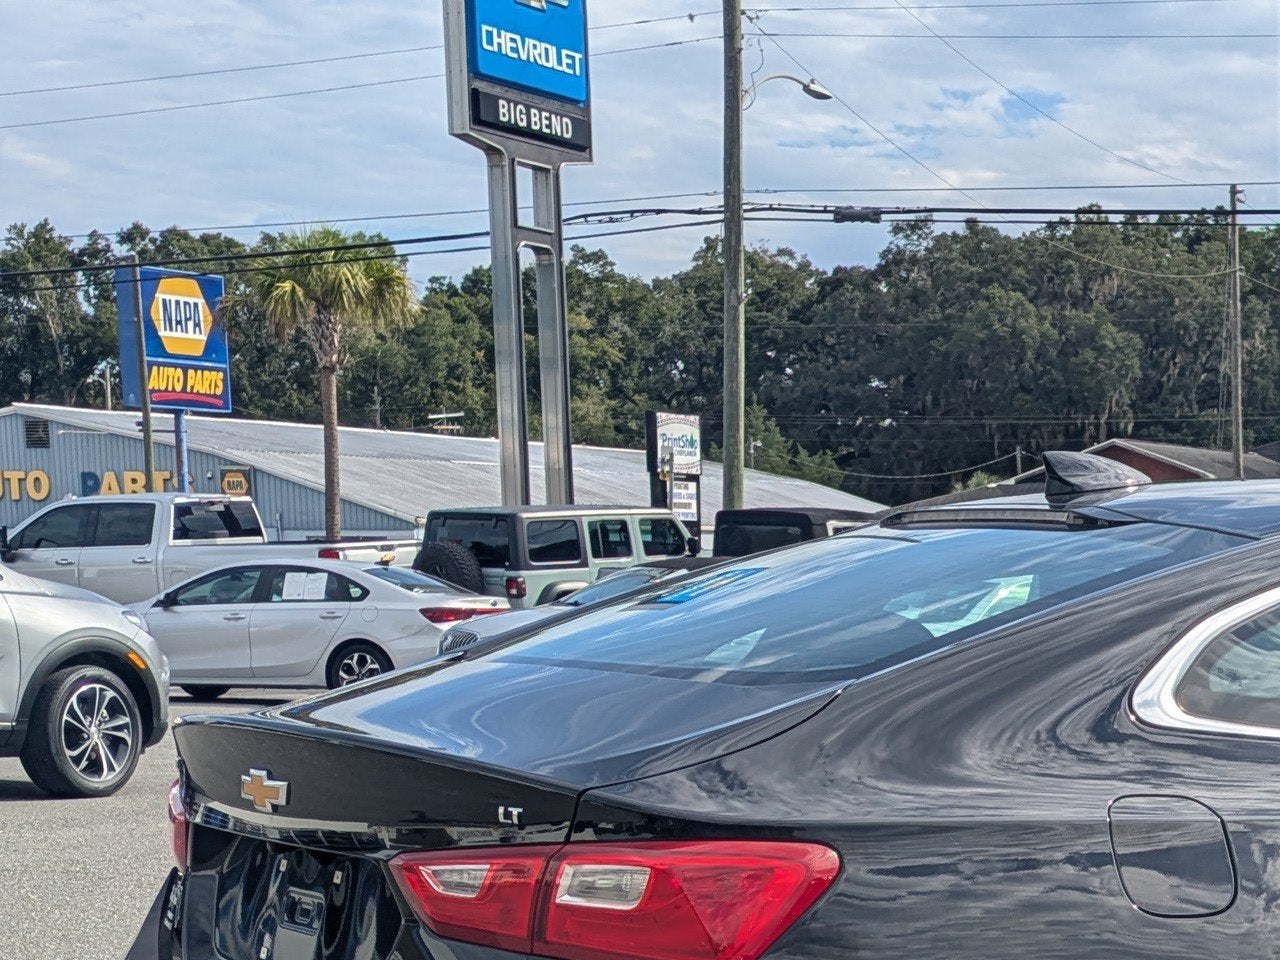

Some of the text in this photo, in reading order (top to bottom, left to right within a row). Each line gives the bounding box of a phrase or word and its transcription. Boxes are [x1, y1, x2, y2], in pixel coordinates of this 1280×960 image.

[481, 24, 583, 76] CHEVROLET
[498, 99, 573, 139] BIG BEND
[162, 298, 203, 335] NAPA
[149, 366, 224, 396] AUTO PARTS
[0, 470, 50, 500] TO
[498, 805, 524, 825] LT
